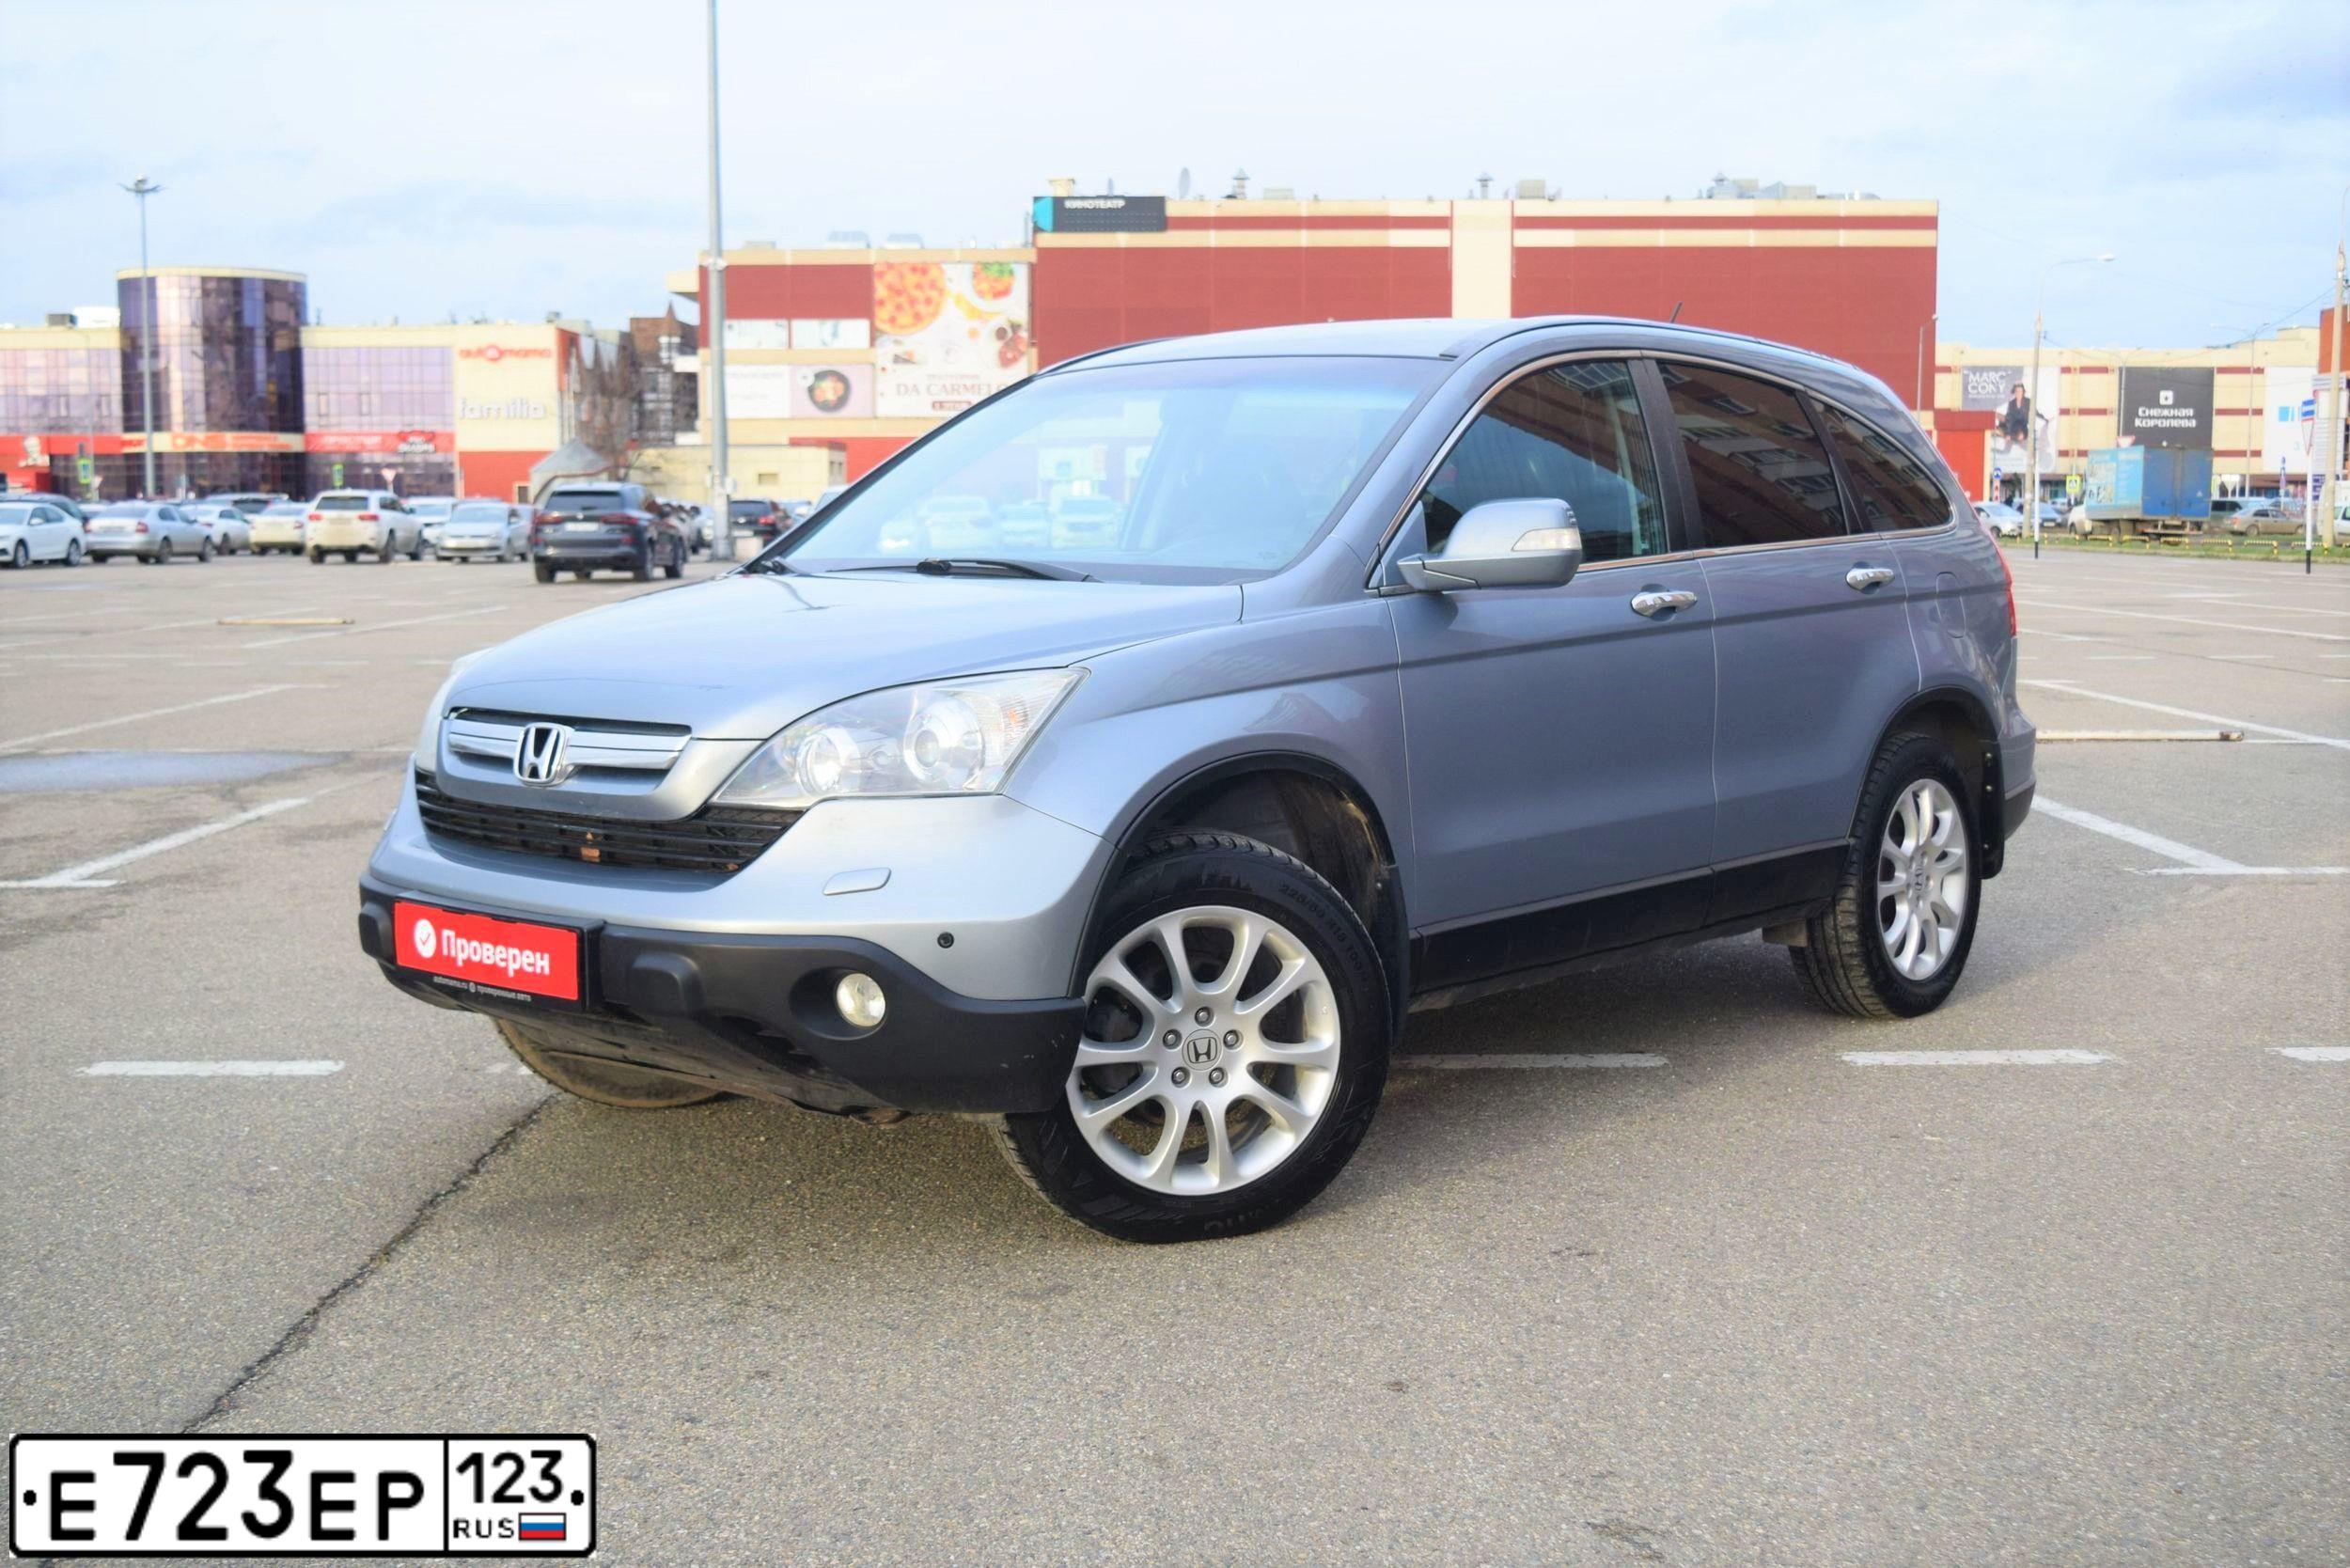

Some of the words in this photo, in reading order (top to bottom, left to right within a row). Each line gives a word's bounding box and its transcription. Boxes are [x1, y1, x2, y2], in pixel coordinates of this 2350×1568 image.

[1064, 198, 1126, 209] КИНОТЕАТР
[2138, 406, 2194, 417] Снежная
[2134, 417, 2197, 428] Королева
[441, 928, 551, 978] Проверен
